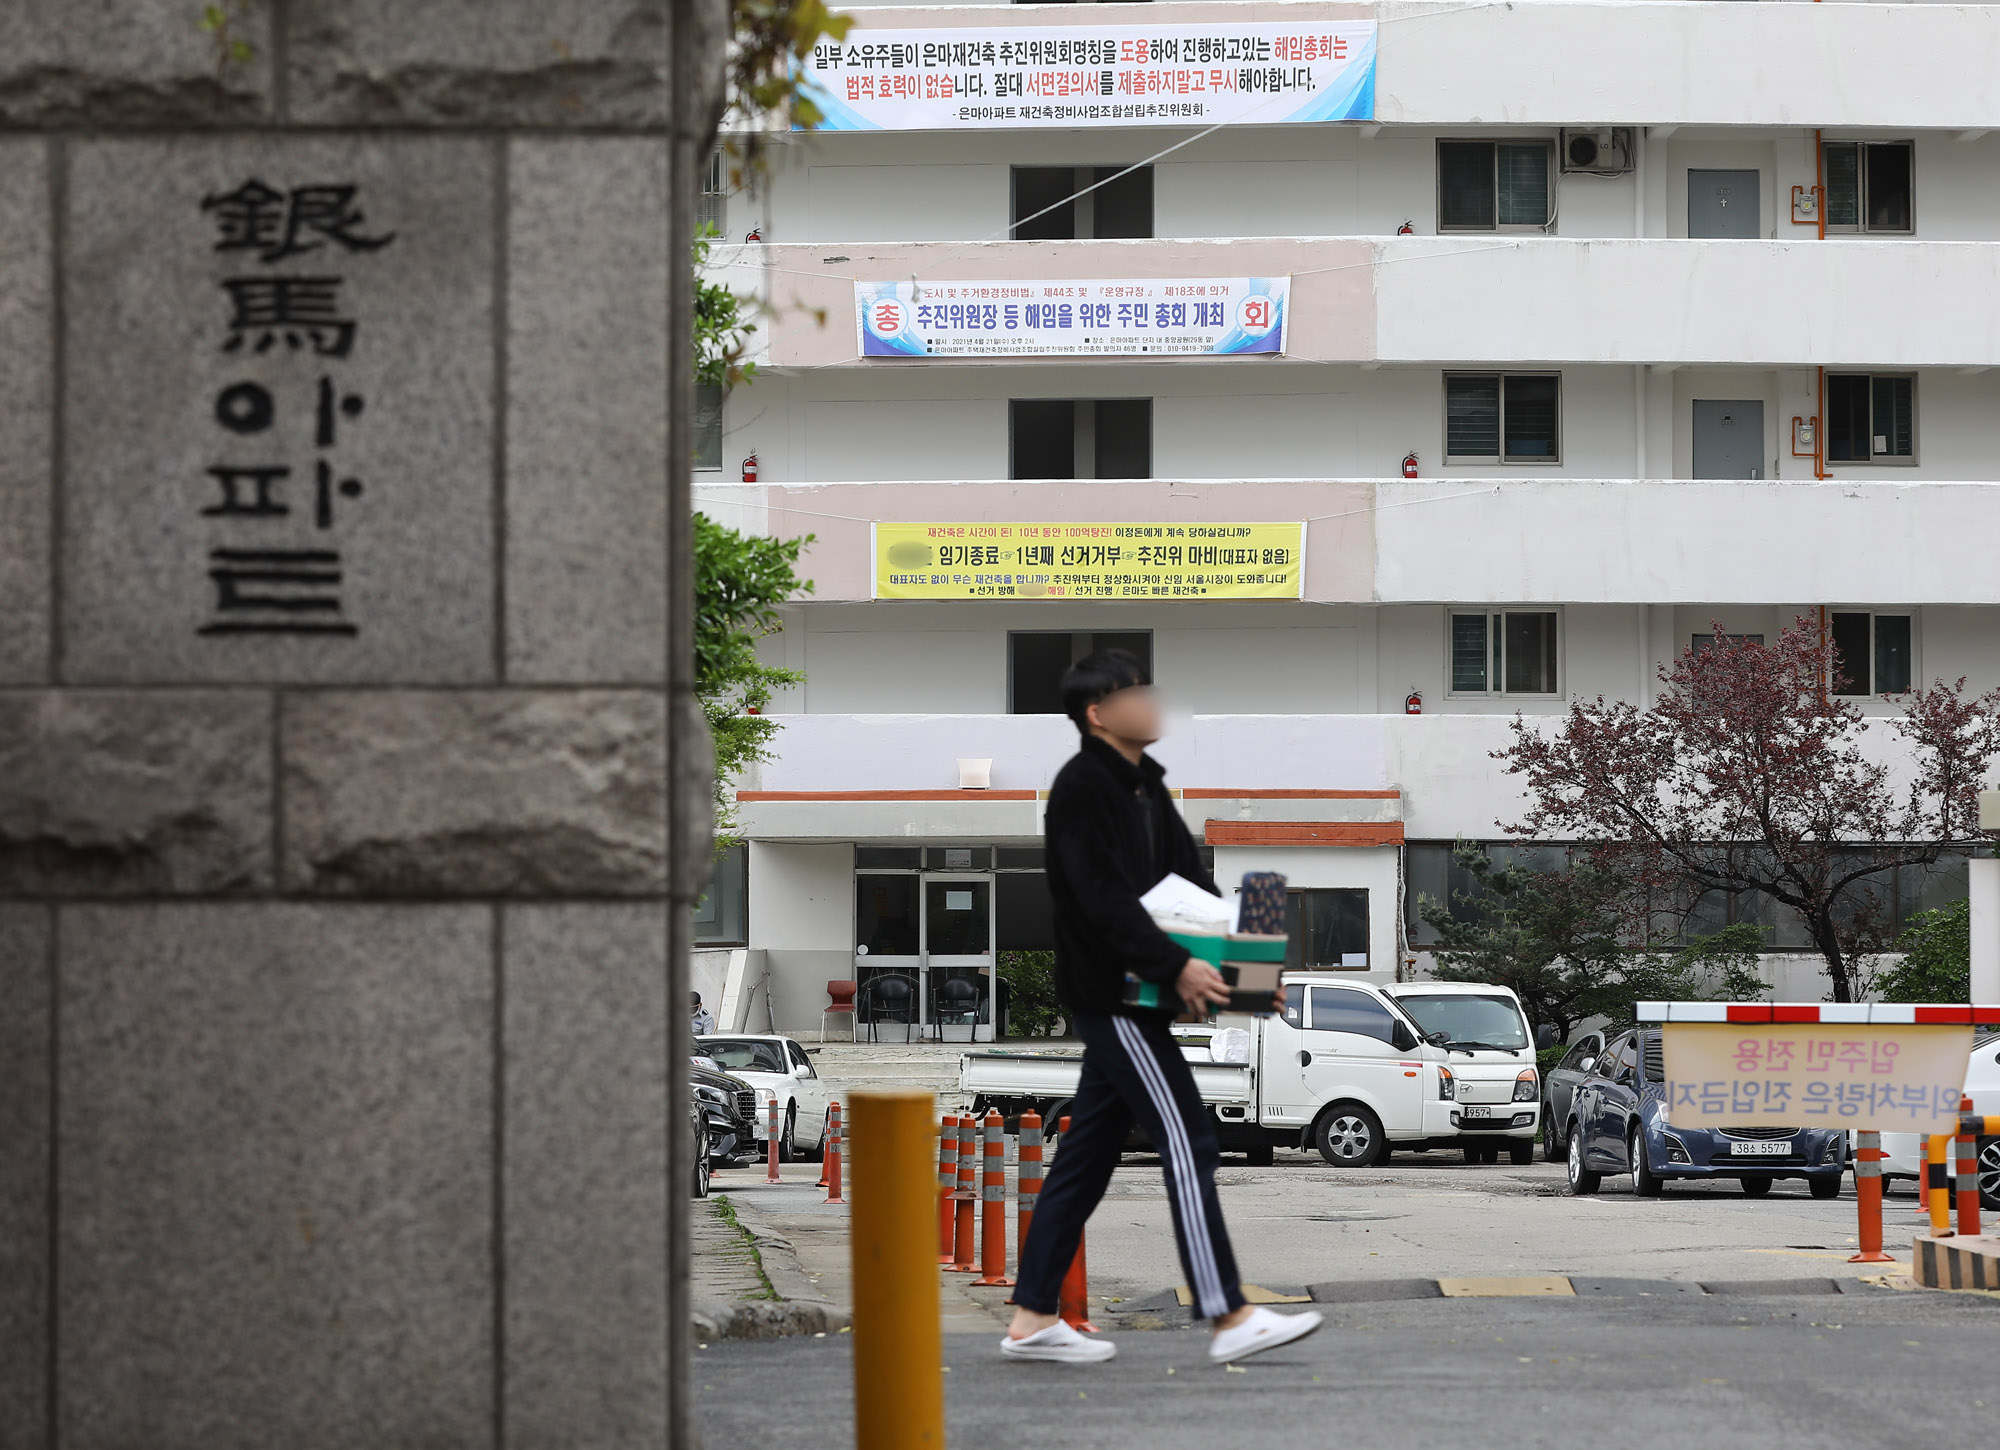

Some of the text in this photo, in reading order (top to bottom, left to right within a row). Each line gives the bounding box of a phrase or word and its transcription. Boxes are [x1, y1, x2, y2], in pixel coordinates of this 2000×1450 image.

[814, 35, 1348, 69] 일부 소유주들이 은마재건축 추진위원회명칭을 도용하여 진행하고있는 해임총회는
[846, 66, 1316, 100] 법적 효력이 없습니다. 절대 서면결의서를 제출하지말고 무시해야합니다.
[959, 103, 1204, 121] 은마아파트 재건축정비사업조합설립추진위원회
[924, 288, 943, 299] 도시
[947, 288, 957, 298] 및
[1043, 287, 1074, 298] 제44조
[1078, 287, 1088, 297] 및
[1164, 286, 1206, 297] 제18조에
[1209, 285, 1229, 297] 의거
[875, 304, 900, 332] 총
[917, 301, 1224, 330] 추진위원장 등 해임을 위한 주민 총회 개최
[1244, 301, 1269, 329] 회
[927, 527, 965, 537] 재건축은
[968, 527, 997, 537] 시간이
[1019, 527, 1039, 537] 10년
[1042, 527, 1061, 537] 동안
[1065, 527, 1112, 537] 100억탕진!
[1166, 527, 1185, 537] 계속
[1188, 527, 1251, 537] 당하실겁니까?
[939, 545, 1000, 566] 임기종료
[1016, 545, 1054, 566] 1년째
[1060, 545, 1121, 566] 선거거부
[1137, 545, 1182, 566] 추진위
[890, 574, 927, 584] 대표자도
[931, 574, 949, 584] 없이
[953, 574, 971, 584] 무슨
[975, 574, 1013, 584] 재건축을
[1016, 574, 1050, 584] 합니까?
[1053, 574, 1100, 584] 추진위부터
[1103, 574, 1161, 584] 정상화시켜야
[1164, 574, 1183, 584] 신임
[1186, 574, 1233, 584] 서울시장이
[977, 586, 994, 595] 선거
[998, 586, 1015, 595] 방해
[1047, 586, 1065, 595] 해임
[1075, 586, 1092, 595] 선거
[1095, 586, 1113, 595] 진행
[1122, 586, 1149, 595] 은마도
[1151, 586, 1170, 595] 빠른
[1172, 586, 1199, 595] 재건축
[1736, 1143, 1787, 1153] 38소 5577
